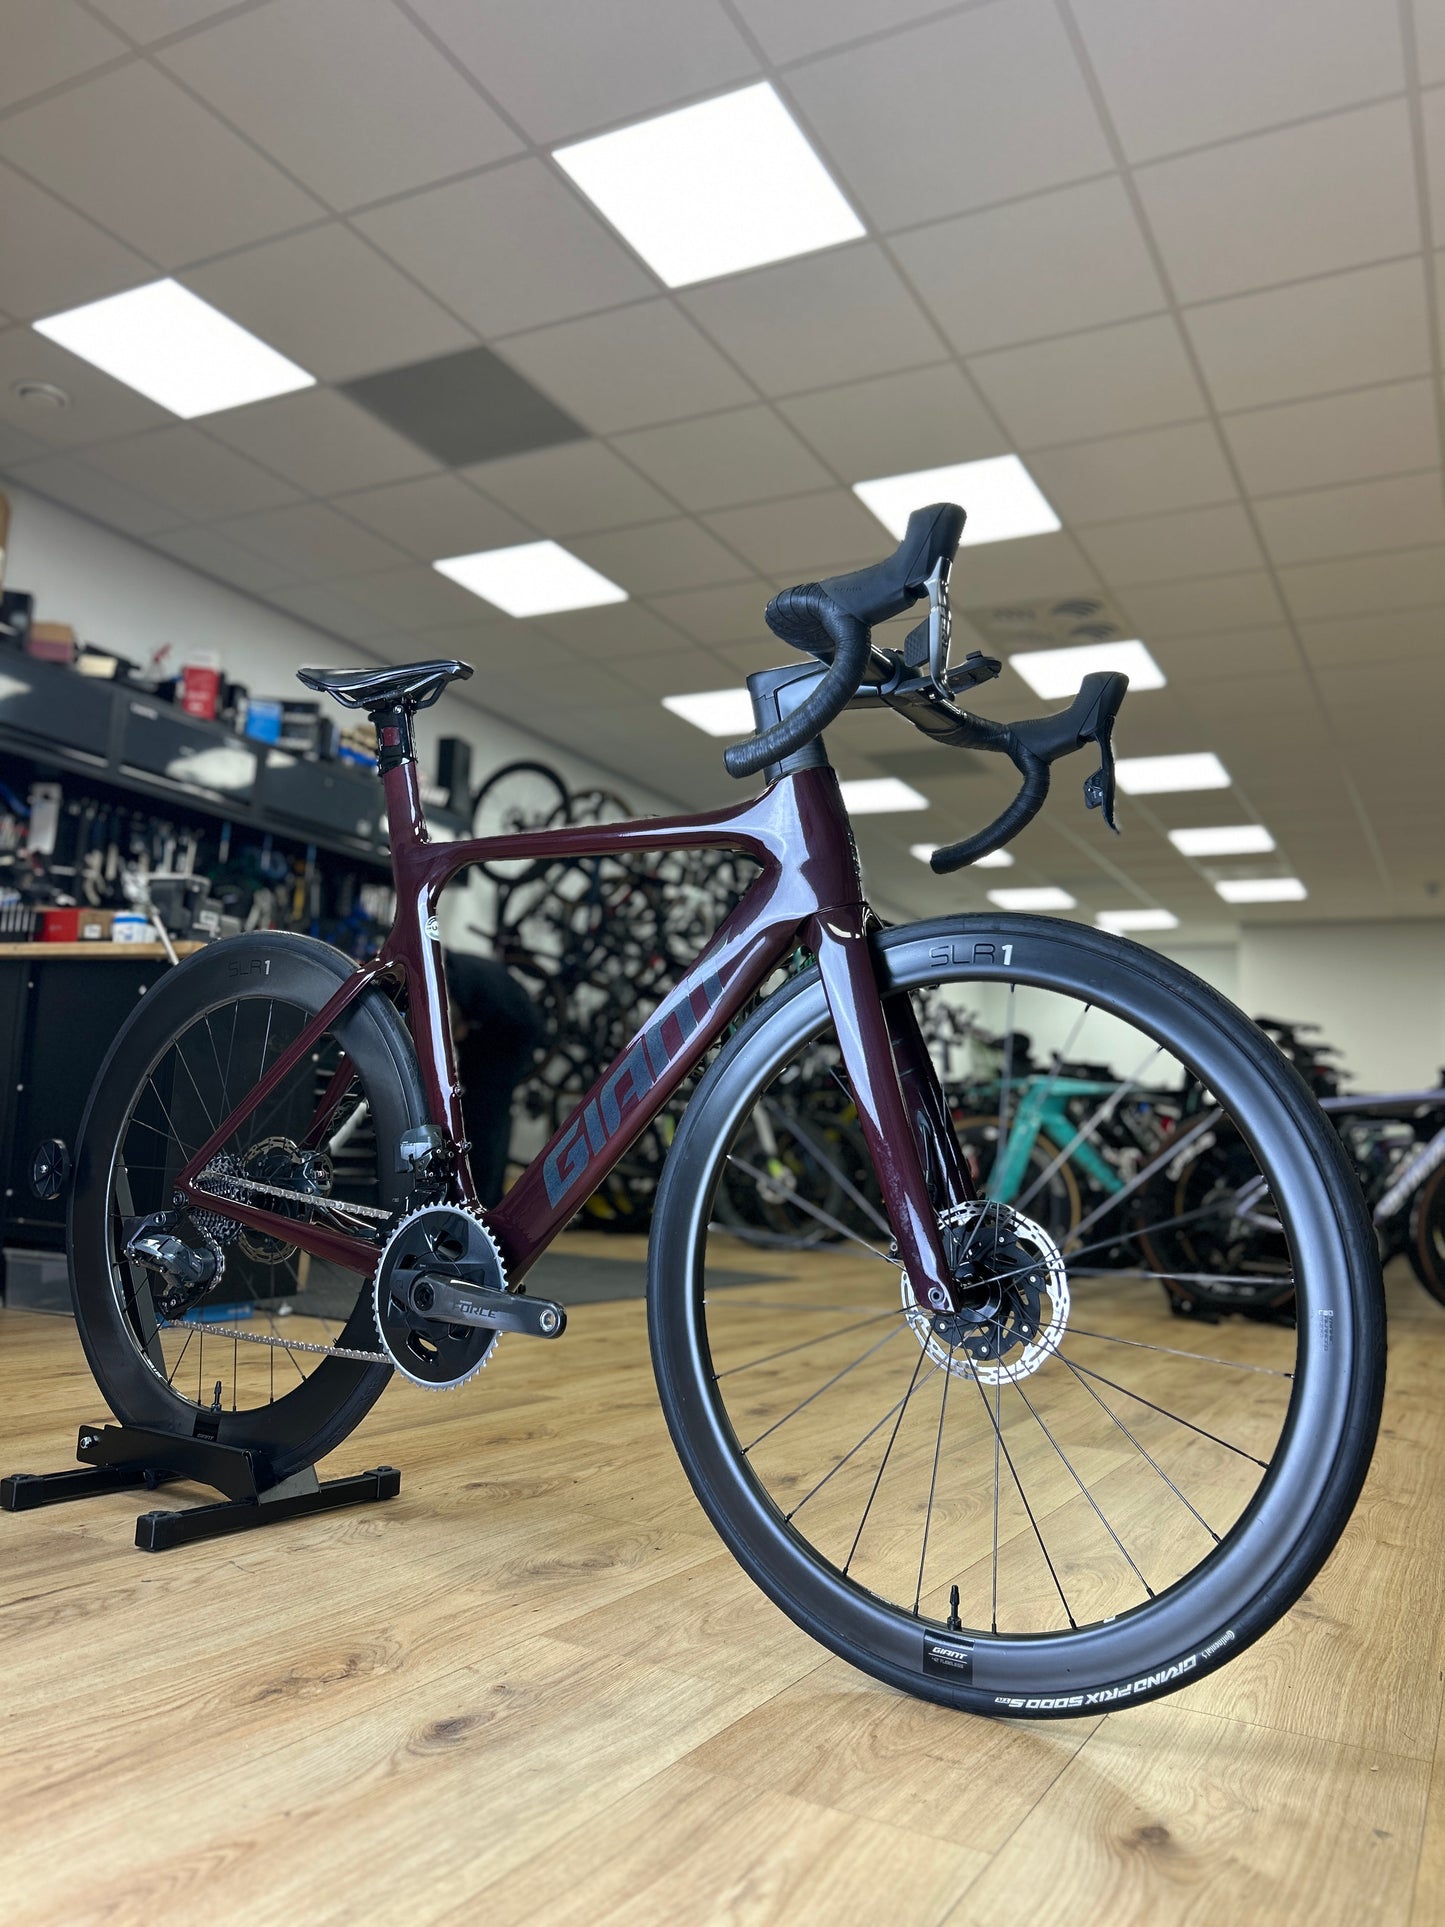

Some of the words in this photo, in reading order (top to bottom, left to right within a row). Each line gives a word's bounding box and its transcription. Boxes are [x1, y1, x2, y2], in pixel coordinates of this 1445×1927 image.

[928, 943, 996, 968] SLR
[1001, 944, 1013, 966] 1
[228, 959, 262, 978] SLR
[264, 959, 271, 975] 1
[543, 925, 732, 1210] GIANT
[452, 1302, 497, 1319] FORCE
[932, 1646, 968, 1660] GIANT
[1205, 1629, 1236, 1658] Continental
[1133, 1654, 1197, 1693] GRAND
[1025, 1695, 1084, 1709] 5000
[1085, 1683, 1132, 1705] PRIX
